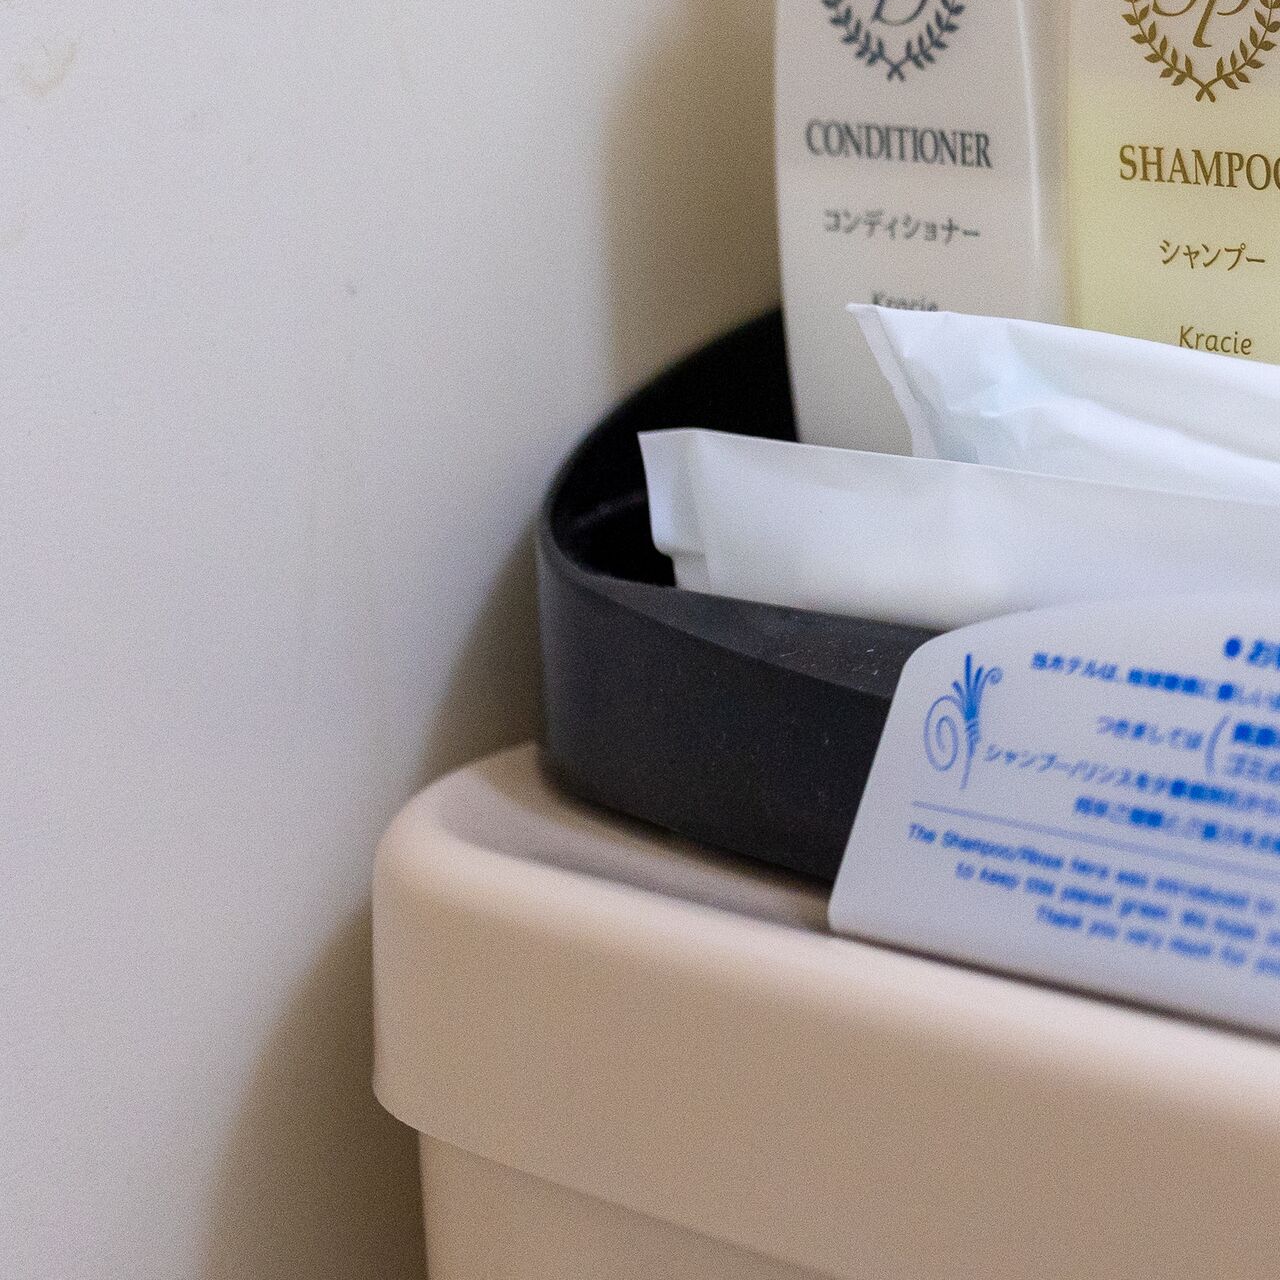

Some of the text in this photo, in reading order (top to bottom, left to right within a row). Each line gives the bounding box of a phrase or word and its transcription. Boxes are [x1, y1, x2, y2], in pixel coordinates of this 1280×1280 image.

[804, 118, 993, 170] CONDITIONER
[823, 206, 982, 247] コンディショナー
[1158, 238, 1268, 274] シャンプー
[1179, 324, 1253, 356] Kracie
[908, 822, 937, 845] The
